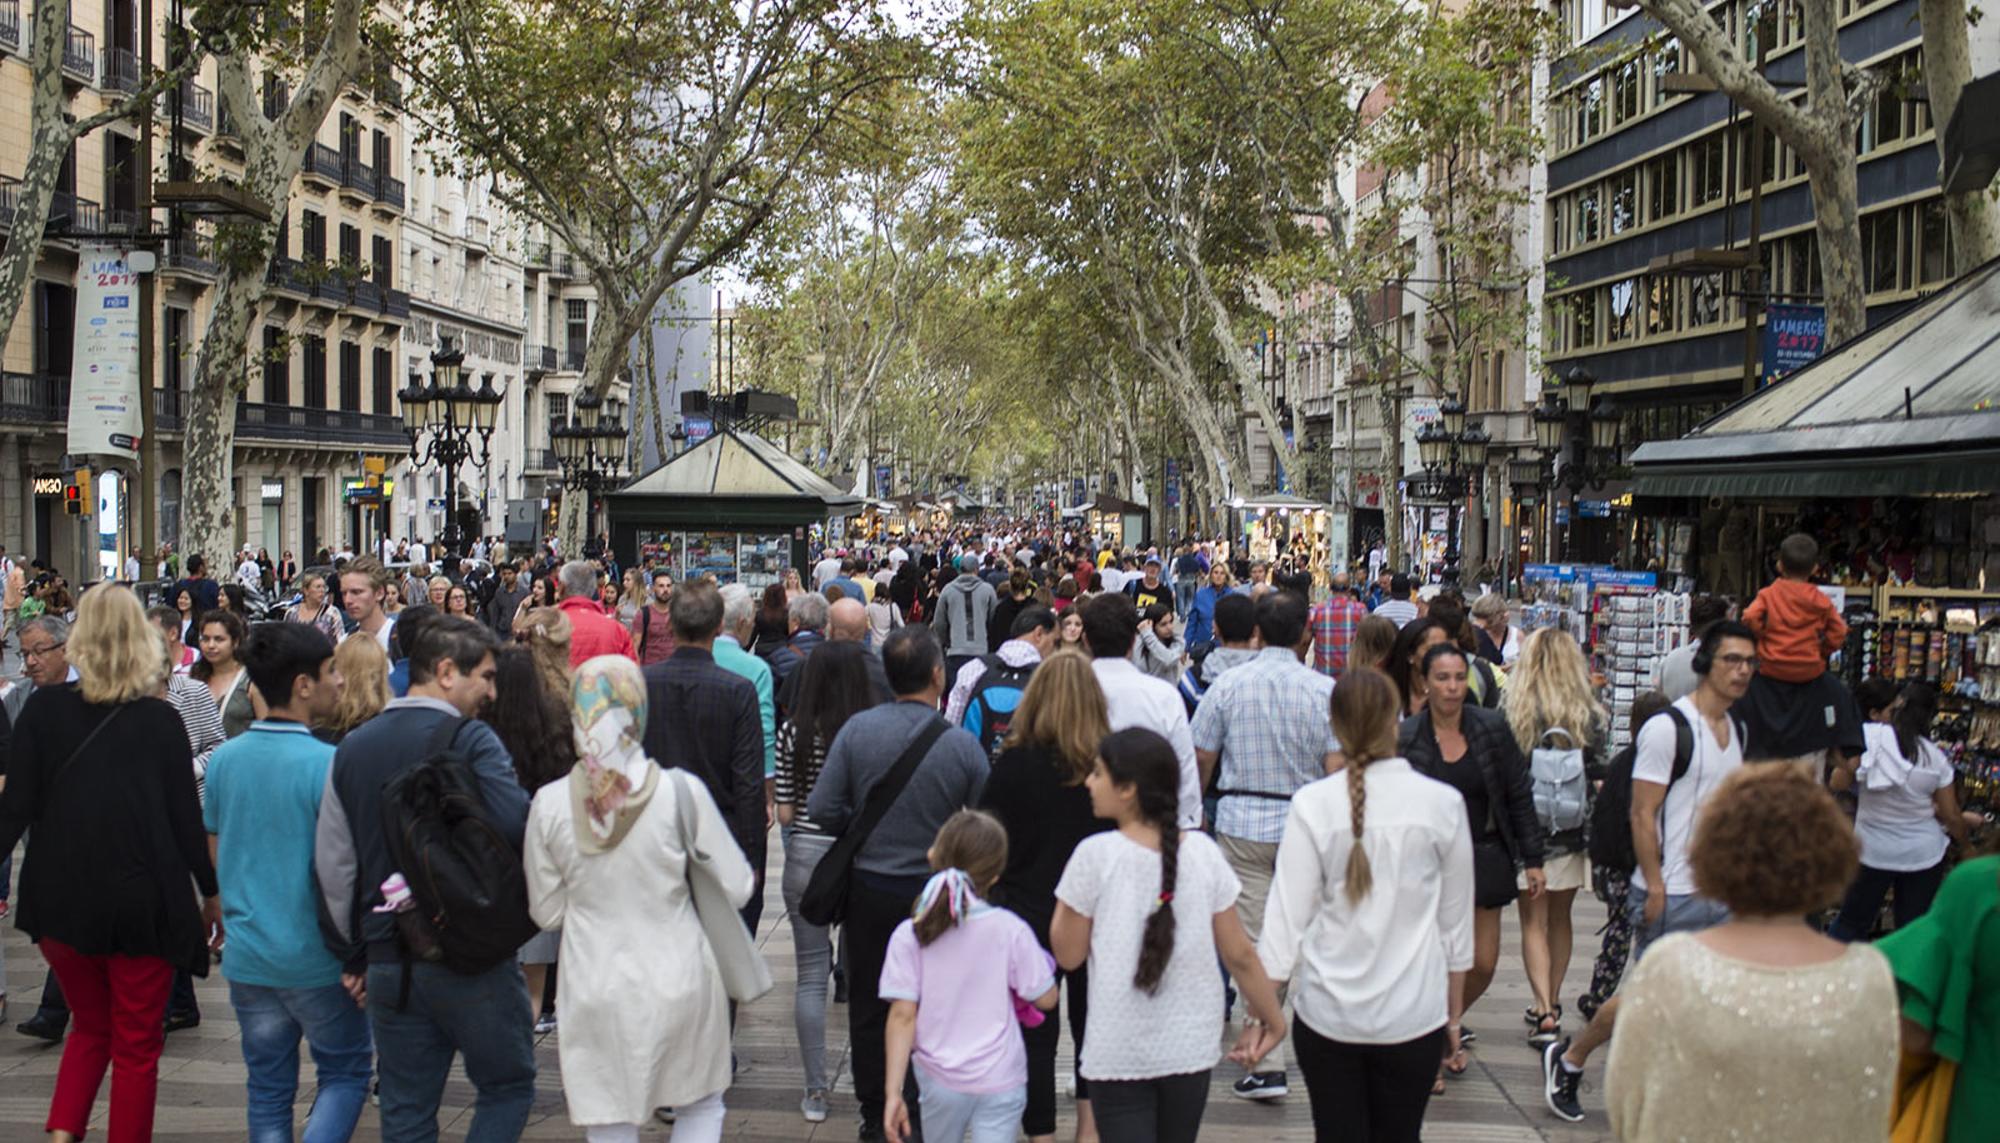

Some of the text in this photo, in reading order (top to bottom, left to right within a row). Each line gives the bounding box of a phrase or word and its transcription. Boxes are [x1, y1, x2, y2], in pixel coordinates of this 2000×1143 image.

[98, 273, 139, 287] 2017
[1777, 332, 1818, 352] 2017
[32, 479, 62, 494] ANGO
